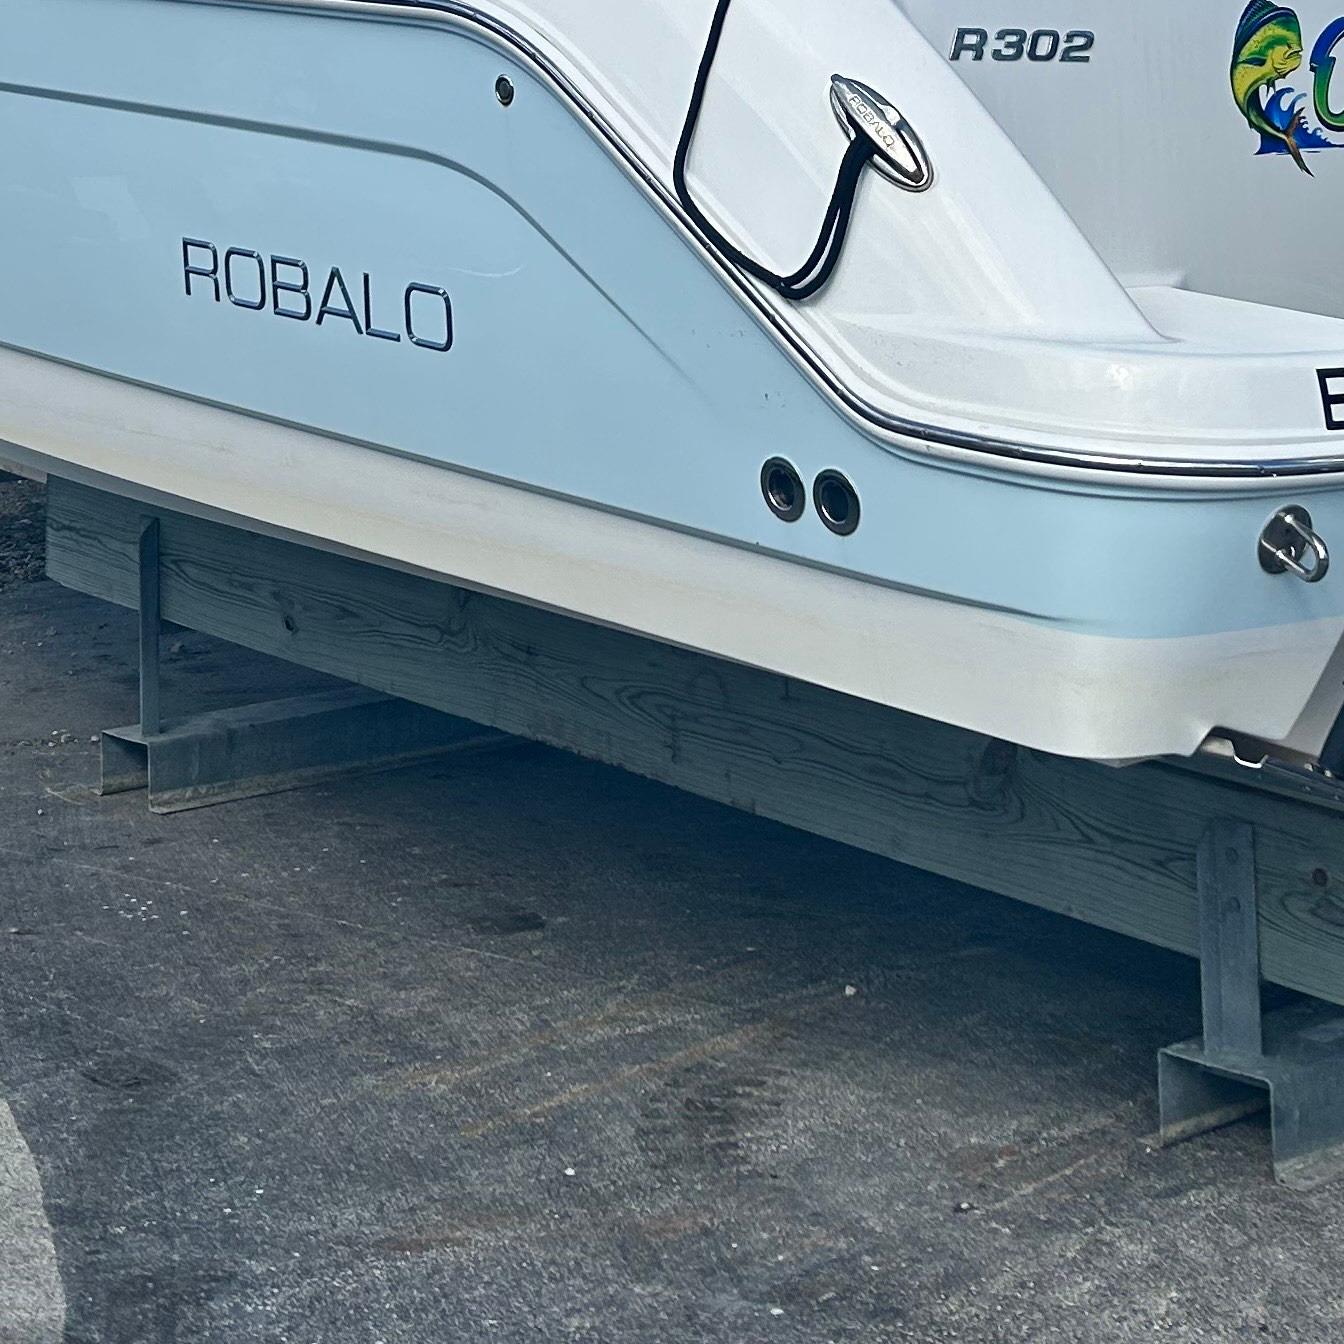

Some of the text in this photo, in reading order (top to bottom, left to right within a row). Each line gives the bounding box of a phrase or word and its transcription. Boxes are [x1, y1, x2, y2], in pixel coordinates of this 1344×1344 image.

[948, 27, 1095, 63] R302
[848, 96, 895, 148] ROBALO
[182, 236, 454, 353] ROBALO
